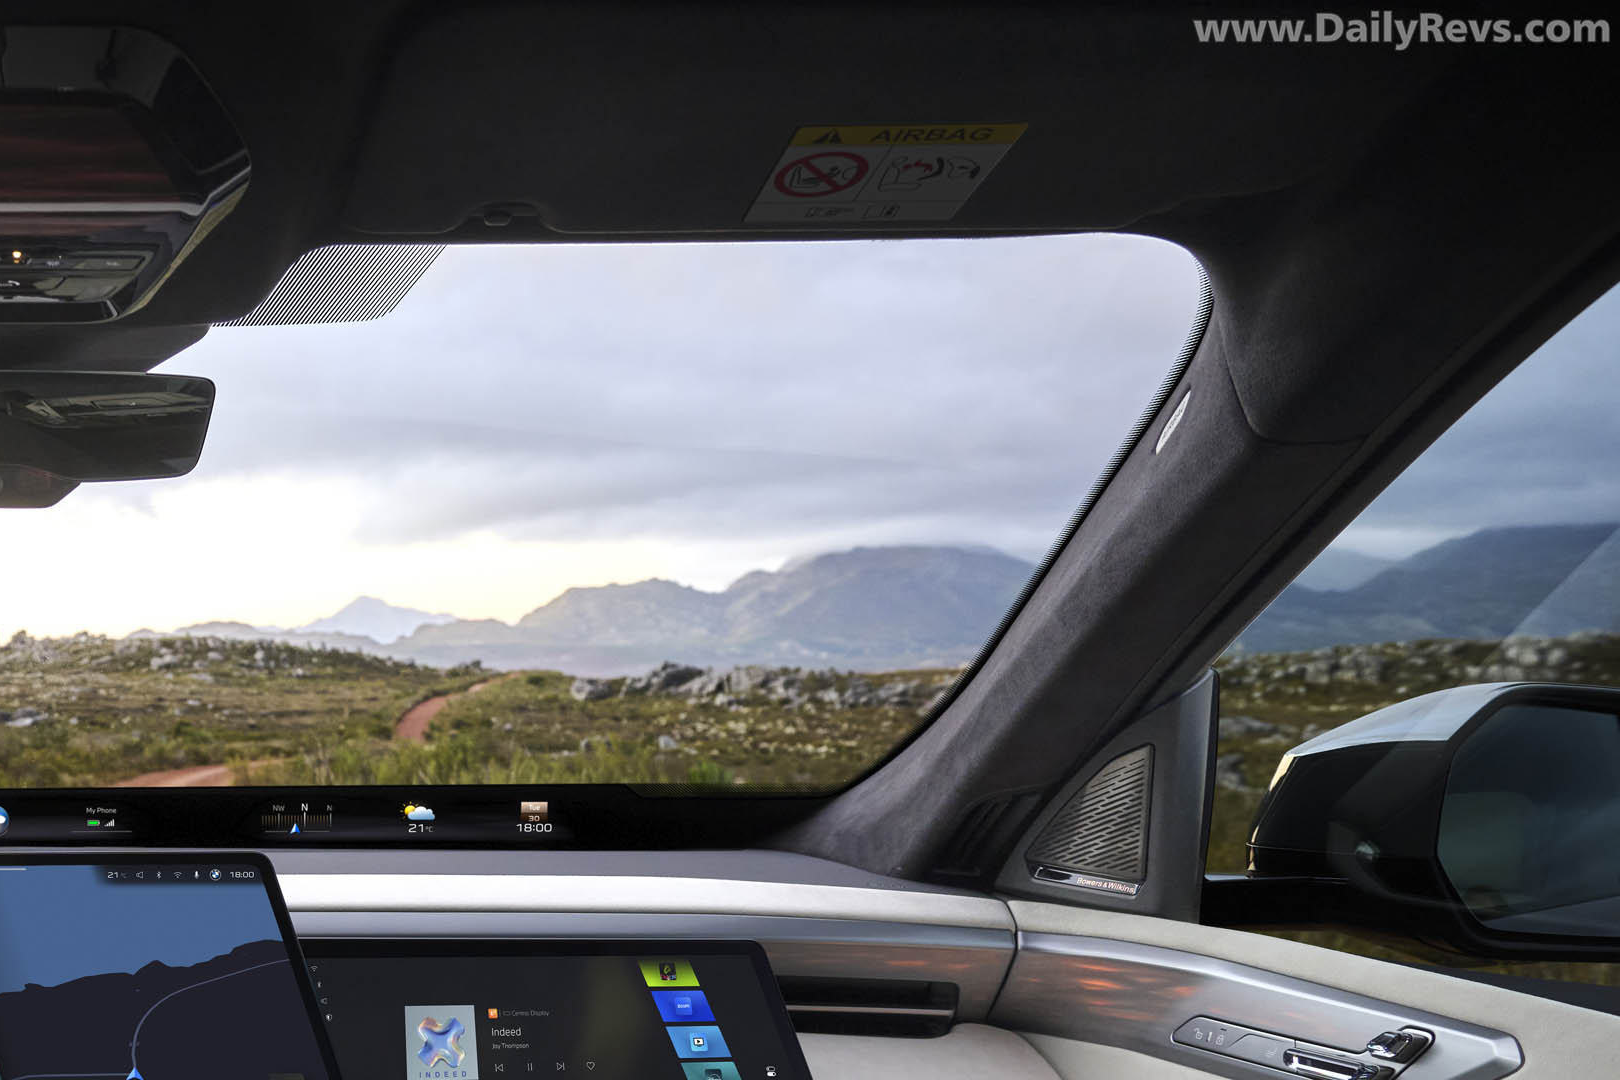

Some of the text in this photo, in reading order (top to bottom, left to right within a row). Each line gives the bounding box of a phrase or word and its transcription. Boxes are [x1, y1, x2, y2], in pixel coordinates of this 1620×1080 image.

[870, 128, 994, 142] AIRBAG
[86, 807, 96, 815] My
[301, 803, 309, 812] N
[516, 823, 553, 833] 18:00
[230, 871, 255, 879] 18:00
[1076, 877, 1101, 887] Bowers
[1108, 881, 1135, 893] Wilkins
[491, 1027, 522, 1037] Indeed
[419, 1071, 467, 1079] INDEED
